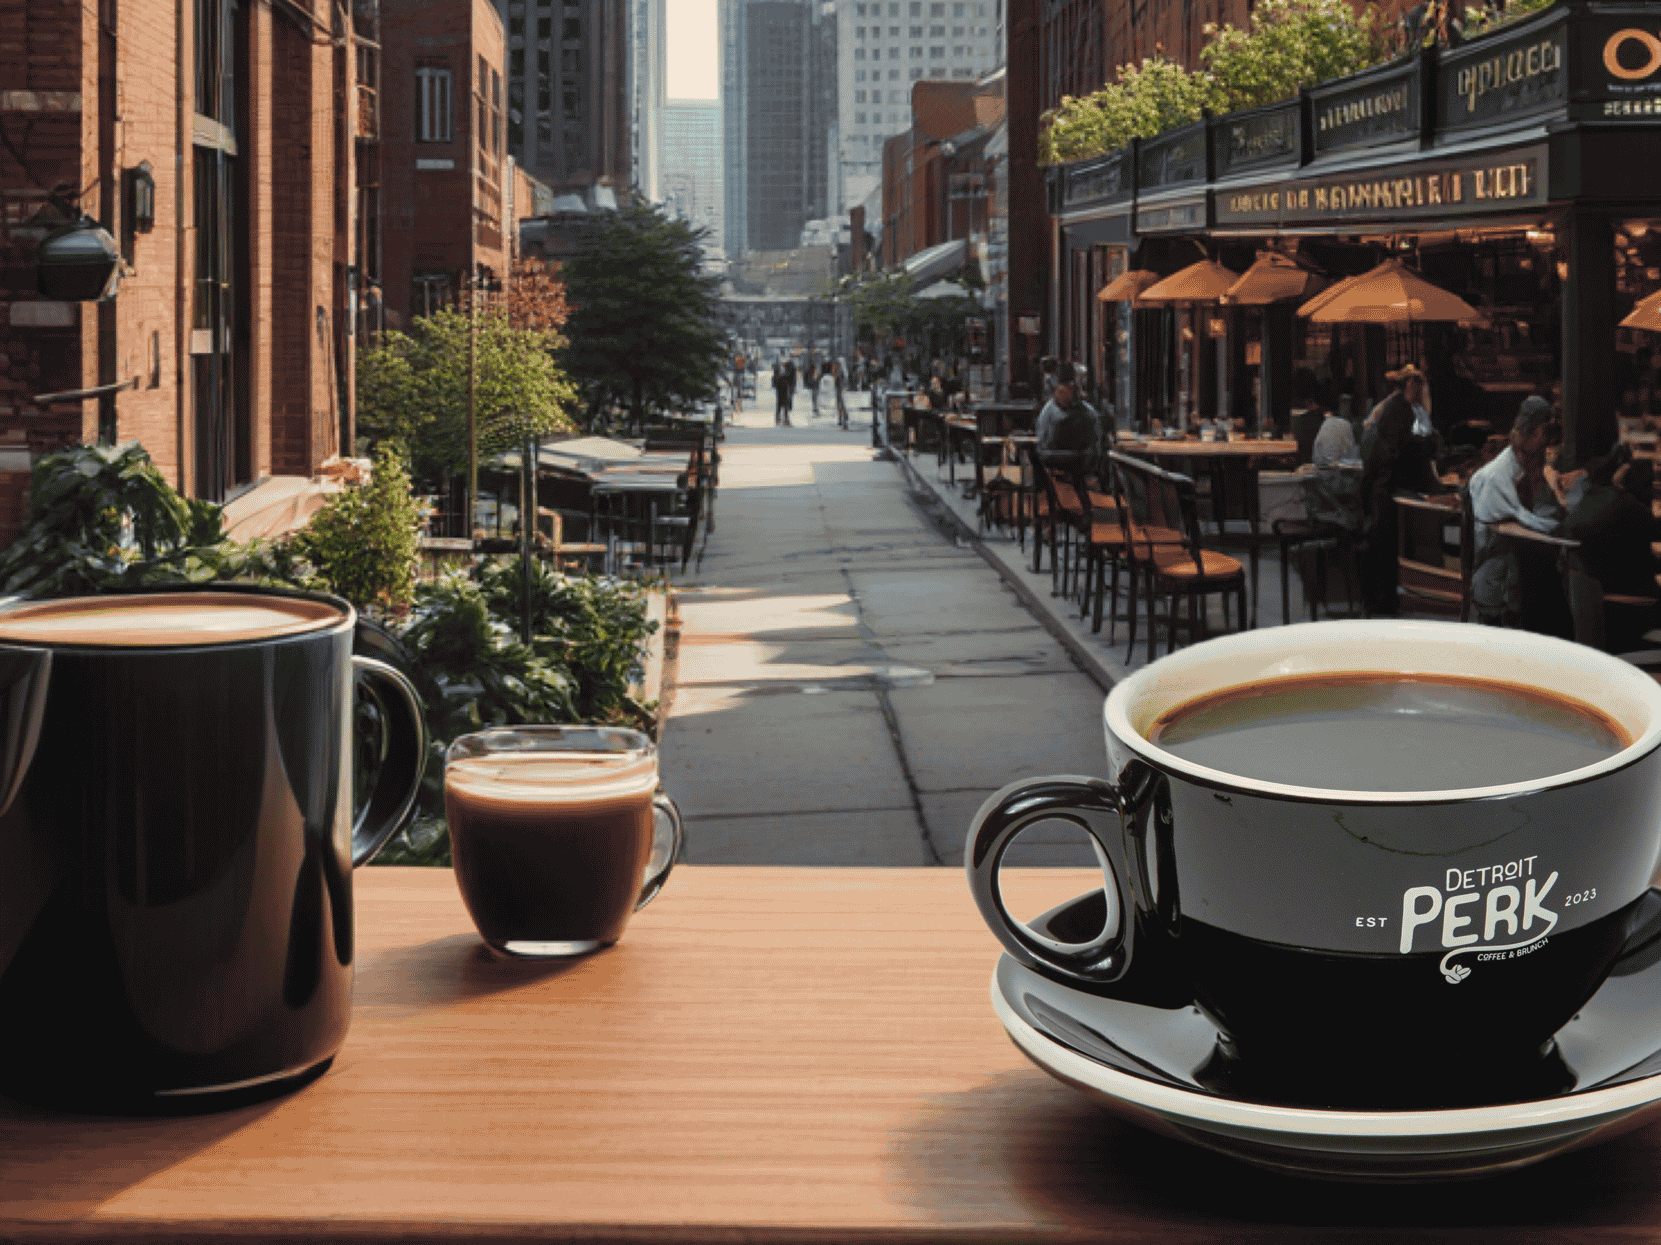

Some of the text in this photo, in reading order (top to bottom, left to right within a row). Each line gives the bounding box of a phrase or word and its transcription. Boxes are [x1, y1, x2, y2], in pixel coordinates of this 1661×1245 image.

[1446, 855, 1538, 891] DETROIT
[1564, 887, 1597, 907] 2023
[1355, 916, 1388, 928] EST
[1400, 870, 1559, 955] PERK
[1477, 937, 1549, 962] COFFEE & BRUNCH
